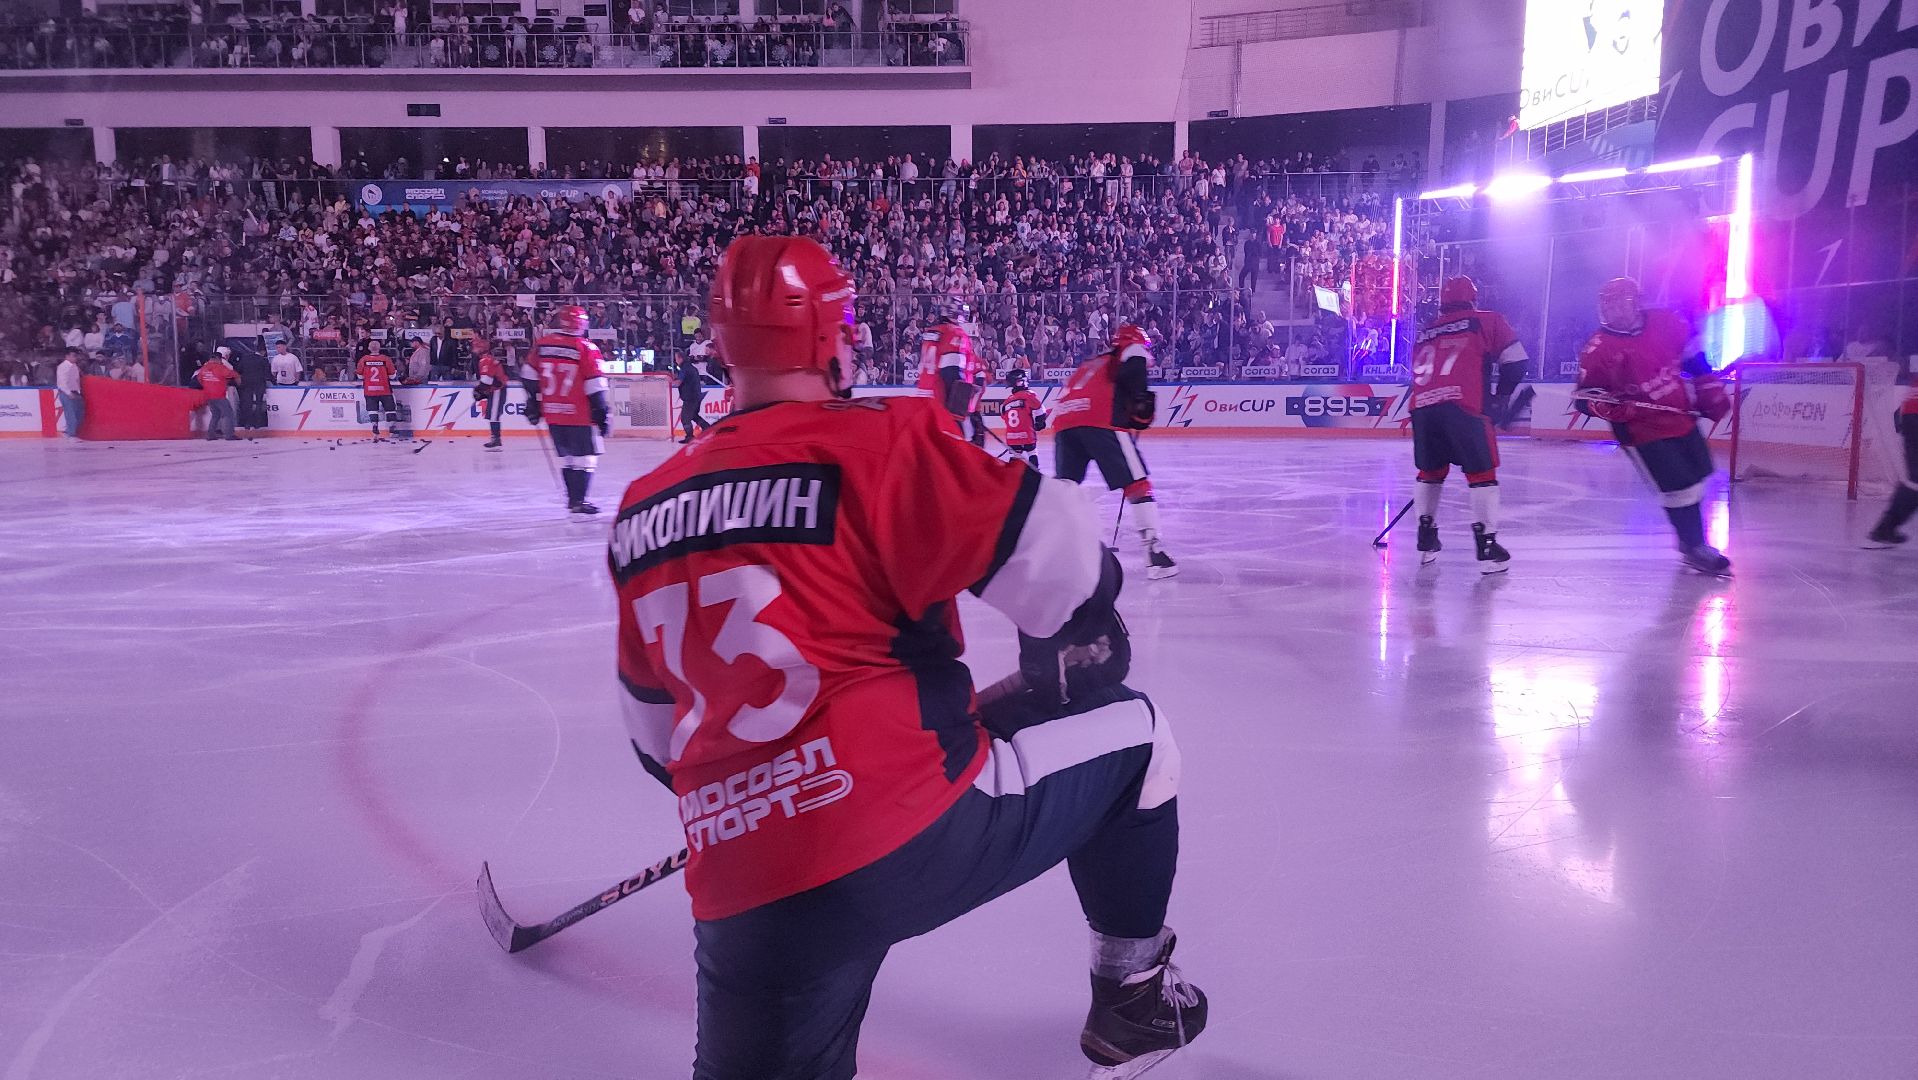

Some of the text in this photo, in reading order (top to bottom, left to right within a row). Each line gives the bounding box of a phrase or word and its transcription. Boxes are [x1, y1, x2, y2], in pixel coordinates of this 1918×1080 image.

[1697, 48, 1918, 221] CUP
[370, 367, 380, 382] 2
[1185, 367, 1217, 376] согаз
[1244, 367, 1277, 376] согаз
[1303, 366, 1336, 375] согаз
[1204, 399, 1276, 413] ОвиCUP
[1304, 396, 1370, 417] 895
[1007, 409, 1020, 428] 8
[632, 565, 820, 762] 73
